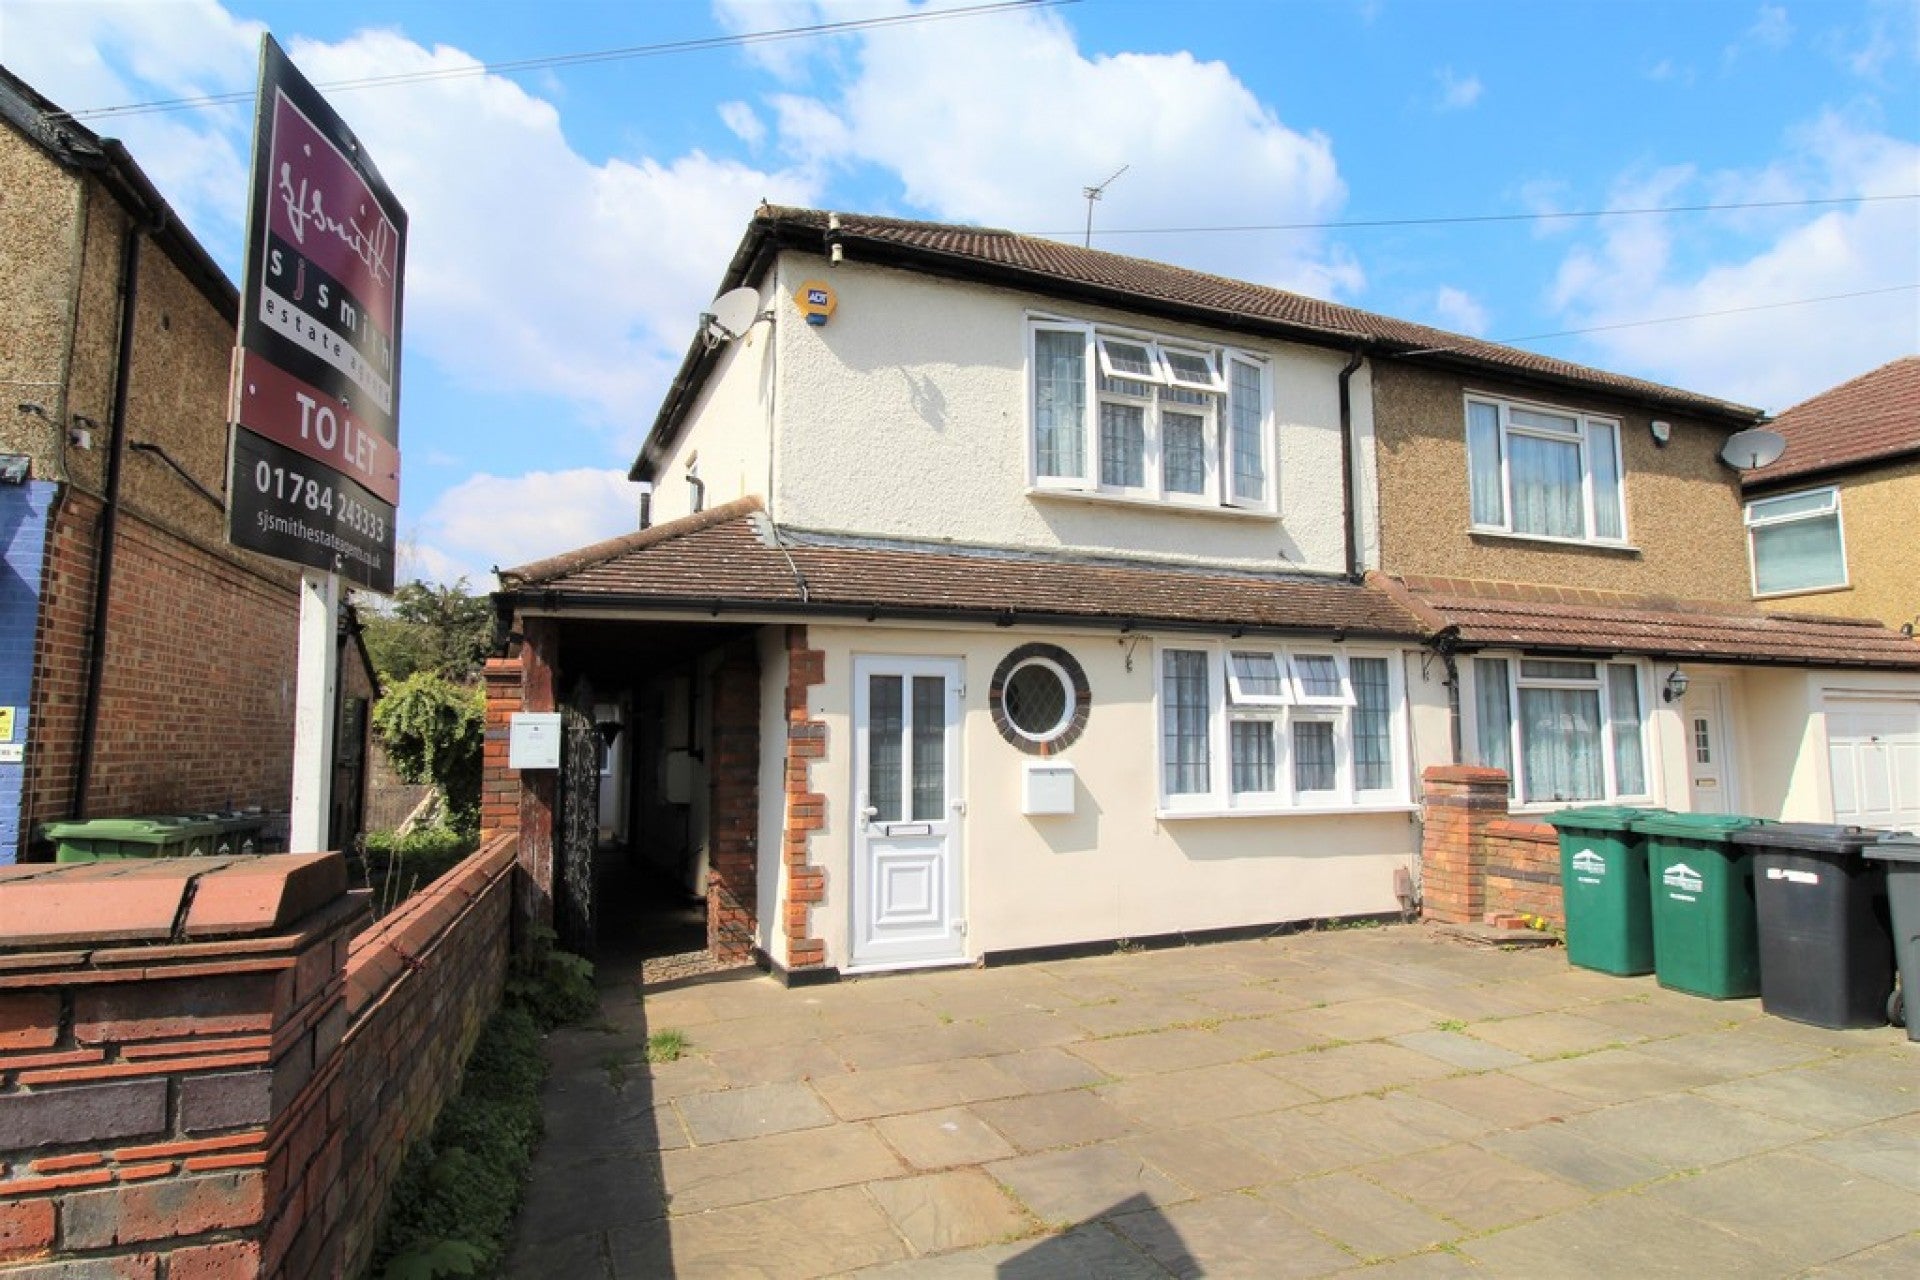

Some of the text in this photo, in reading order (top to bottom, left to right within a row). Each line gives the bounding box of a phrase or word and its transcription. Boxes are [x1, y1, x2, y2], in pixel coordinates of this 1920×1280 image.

[265, 299, 341, 357] estate
[296, 392, 378, 475] TO LET
[256, 460, 384, 543] 01784 243333
